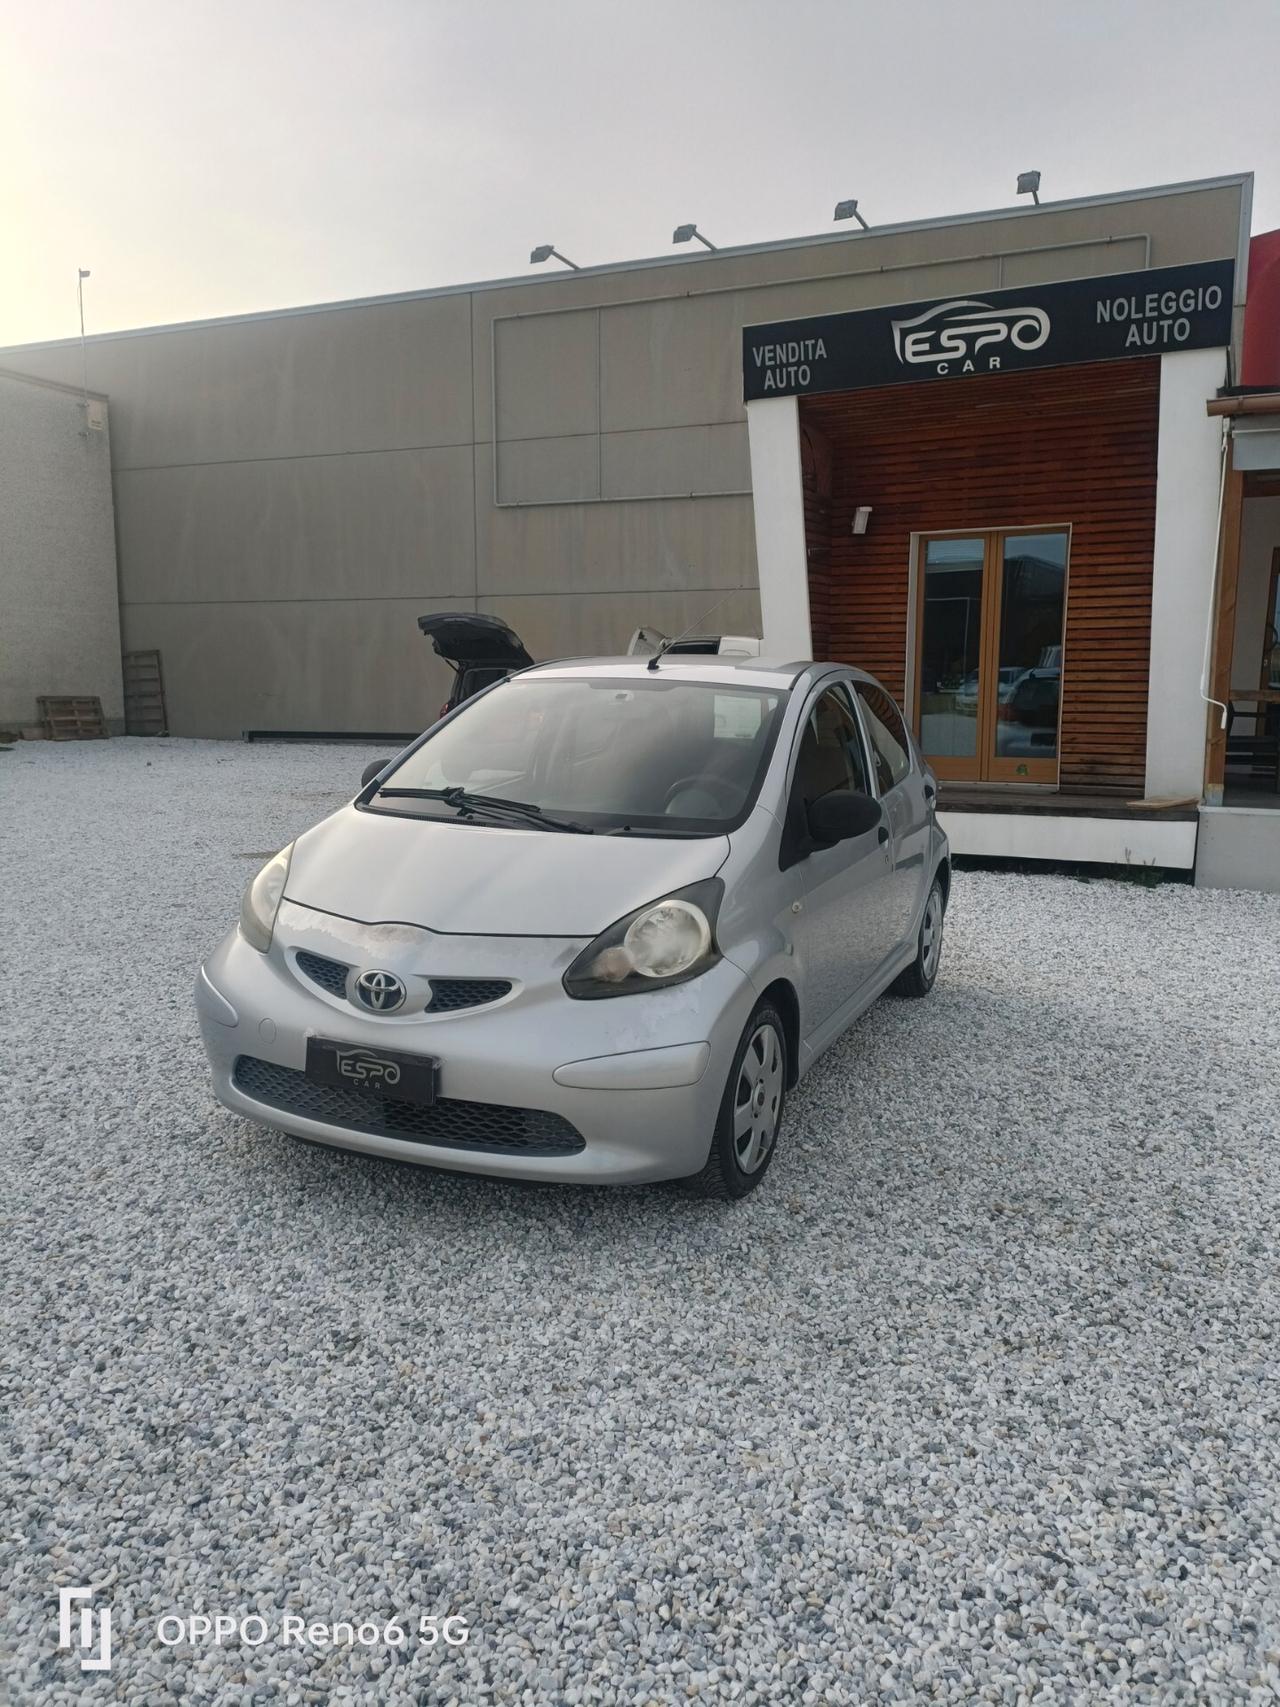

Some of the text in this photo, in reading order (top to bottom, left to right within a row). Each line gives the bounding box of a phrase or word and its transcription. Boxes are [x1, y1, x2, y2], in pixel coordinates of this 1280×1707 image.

[1096, 285, 1222, 324] NOLEGGIO
[902, 306, 1051, 364] ESPO
[1124, 317, 1191, 347] AUTO
[752, 338, 827, 368] VENDITA
[936, 356, 1001, 375] CAR
[764, 364, 811, 390] AUTO
[340, 1056, 401, 1085] ESPO
[353, 1078, 381, 1089] CAR
